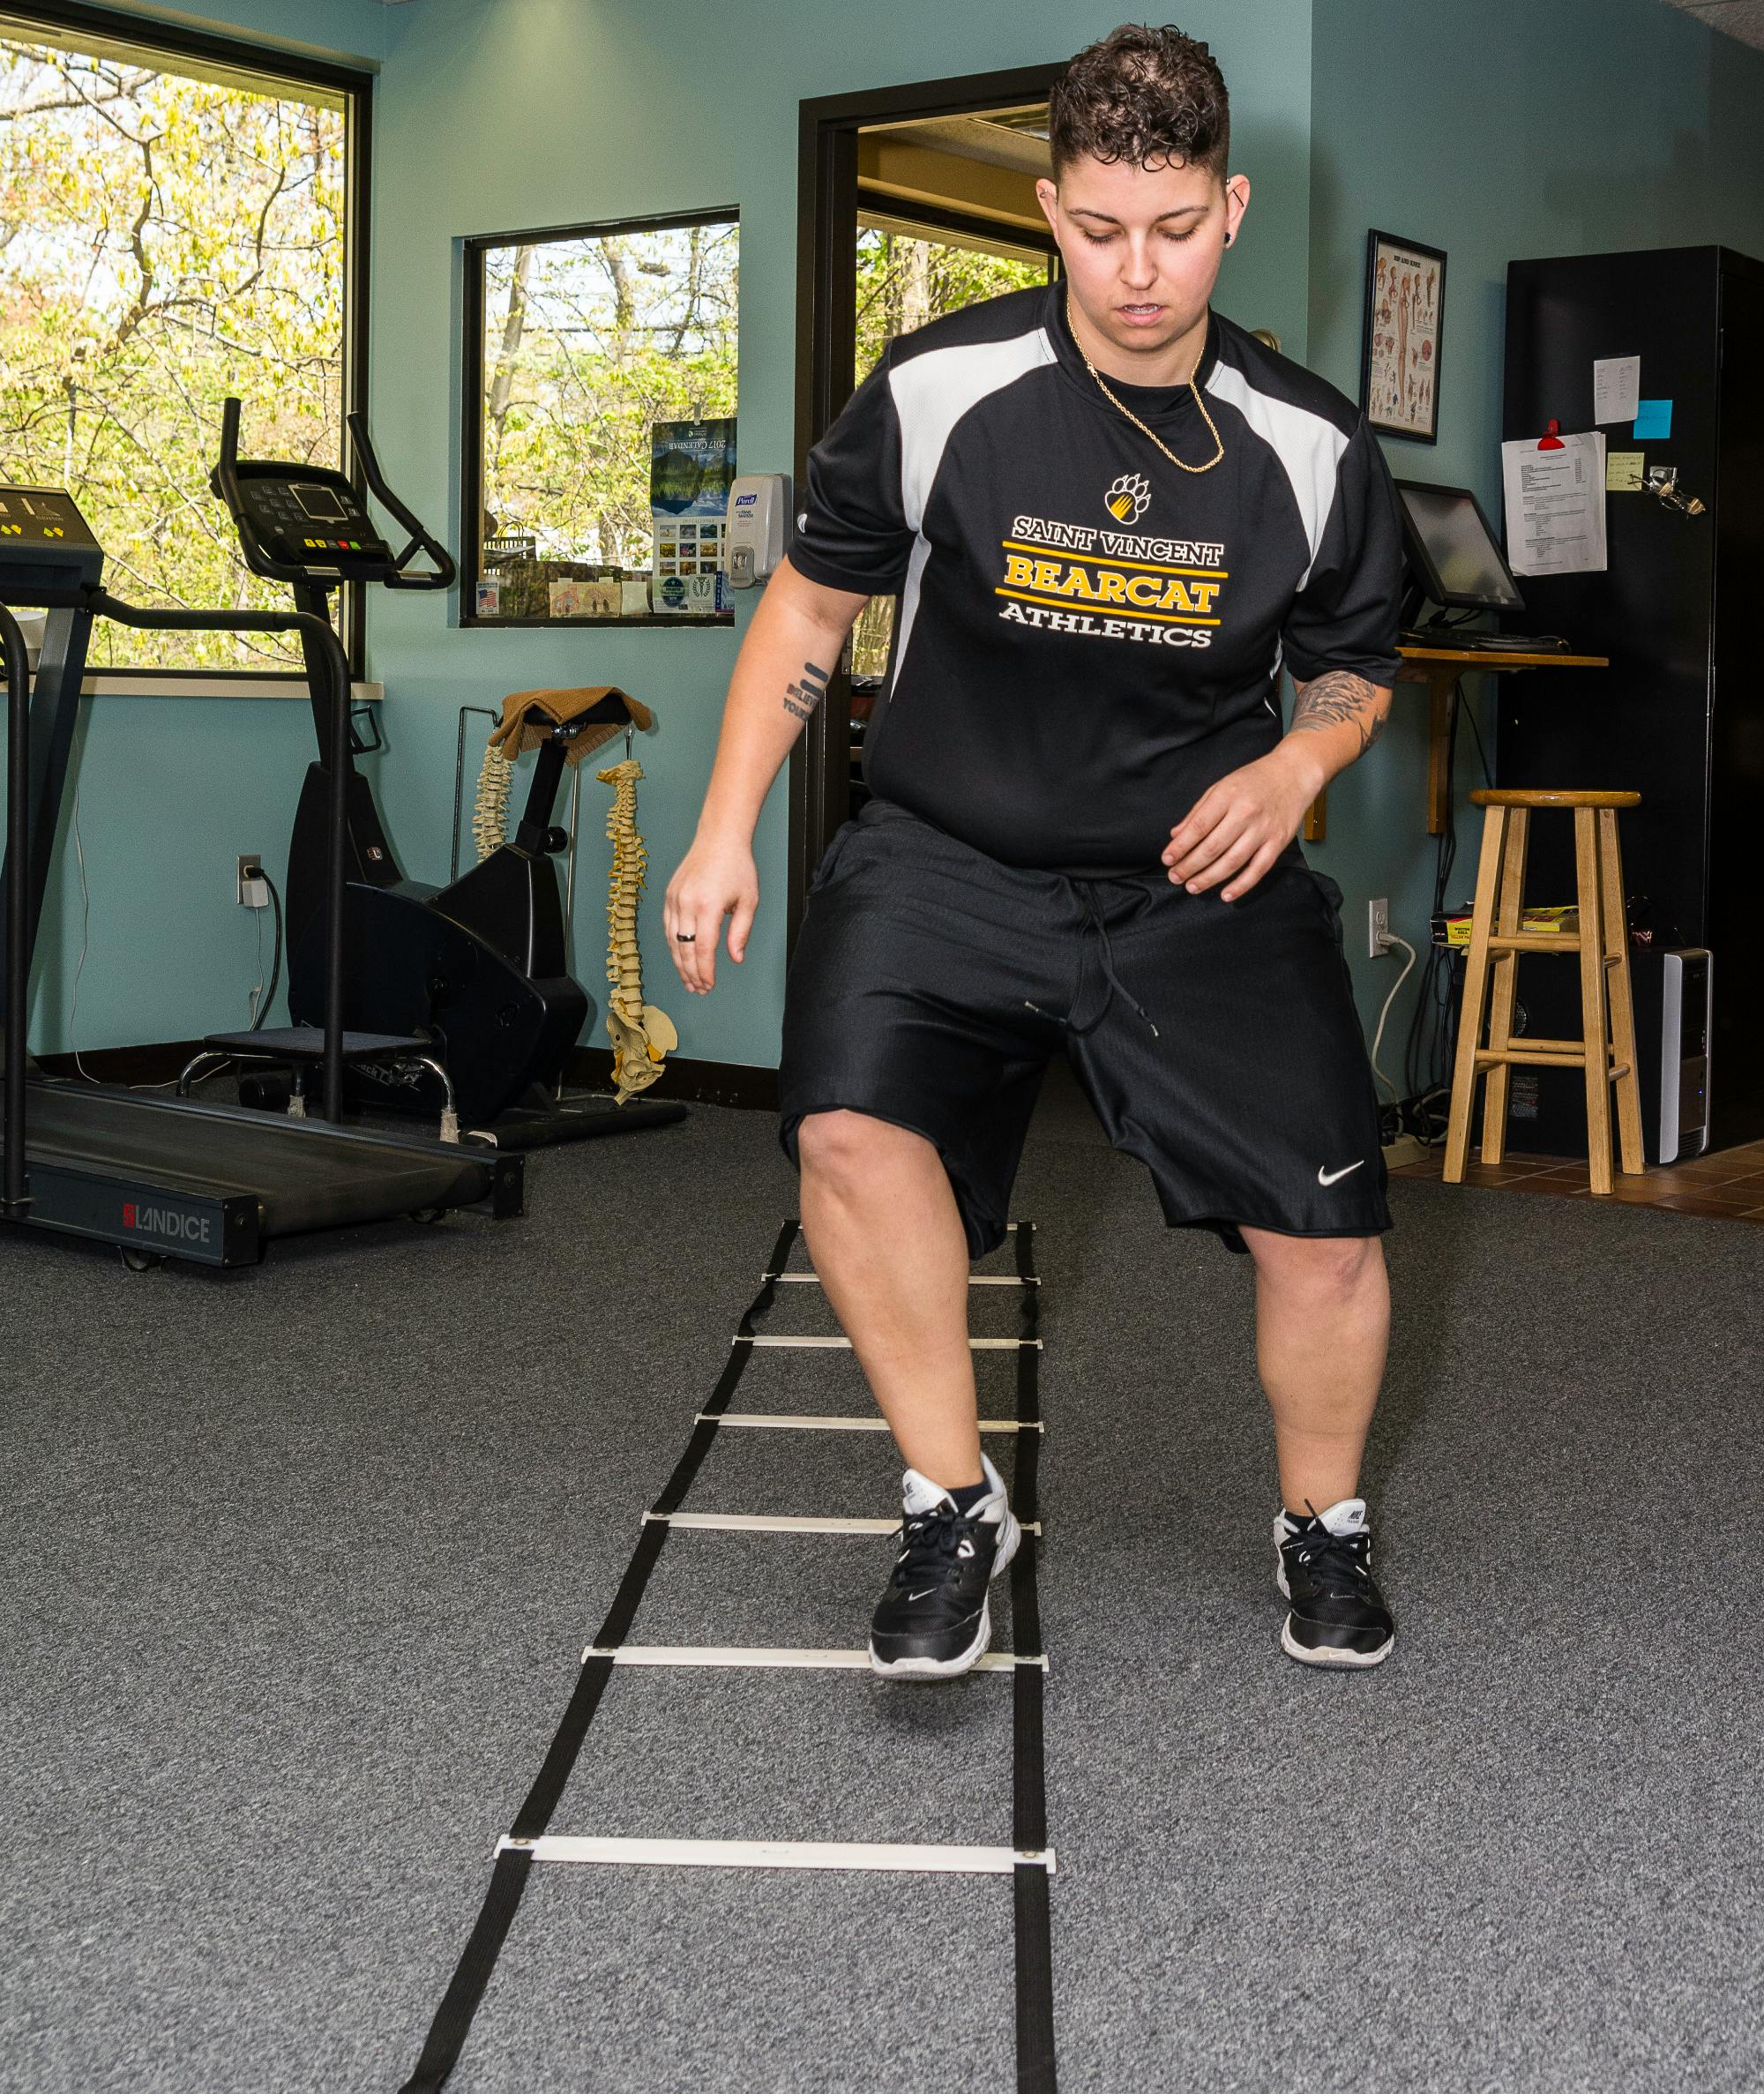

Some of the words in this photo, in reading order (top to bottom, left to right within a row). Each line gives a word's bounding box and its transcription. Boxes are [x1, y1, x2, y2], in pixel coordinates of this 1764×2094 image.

[669, 441, 707, 450] CALENDAR
[709, 439, 726, 449] 2017
[1012, 515, 1096, 551] SAINT
[1100, 530, 1224, 566] VINCENT
[1004, 554, 1220, 613] BEARCAT
[999, 602, 1213, 648] ATHLETICS
[135, 1204, 210, 1244] LANDICE
[1349, 1510, 1363, 1519] NIKE
